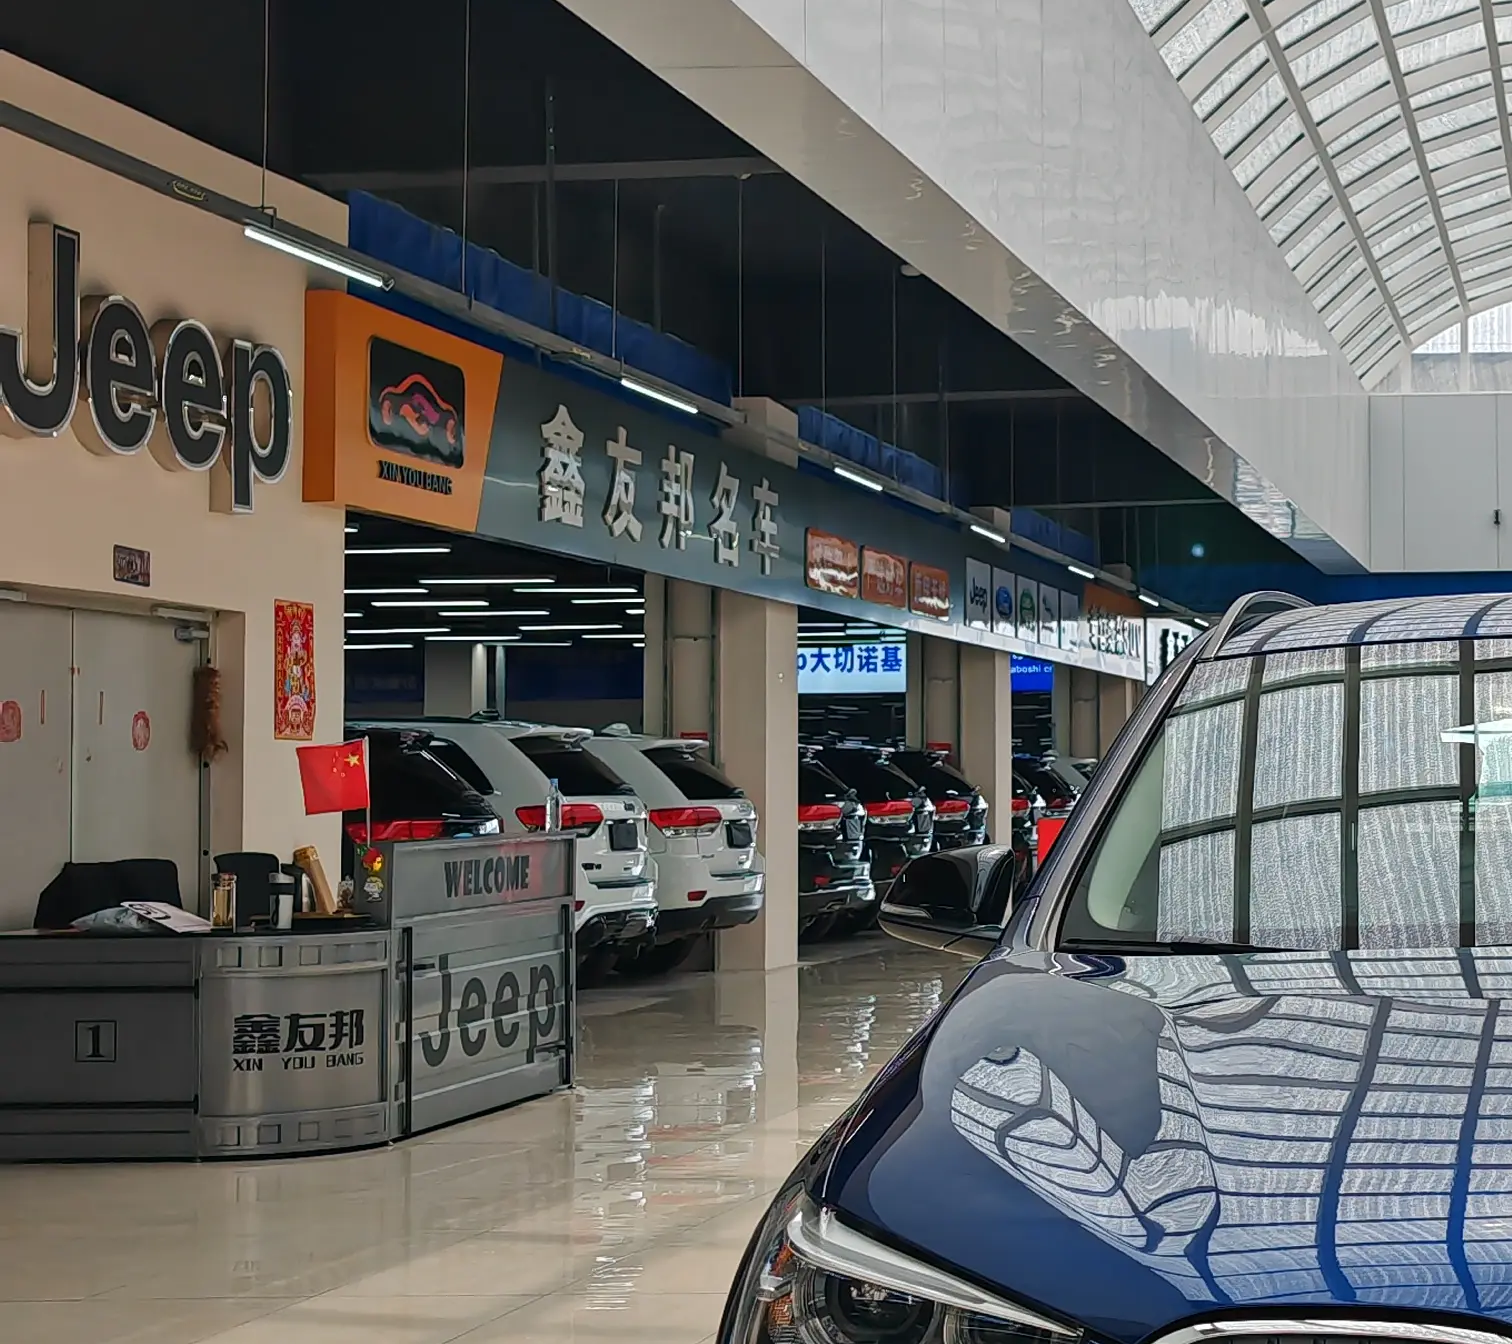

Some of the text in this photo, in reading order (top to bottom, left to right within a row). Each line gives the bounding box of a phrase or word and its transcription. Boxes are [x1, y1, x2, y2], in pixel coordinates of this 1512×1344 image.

[0, 224, 293, 513] Jeep
[380, 460, 453, 495] XIN YOU BANG
[540, 404, 781, 576] 鑫友邦名车
[444, 855, 530, 898] WELCOME
[232, 1009, 364, 1054] 鑫友邦
[421, 954, 556, 1067] Jeep
[86, 1024, 106, 1058] 1
[232, 1052, 364, 1072] XIN YOU BANG
